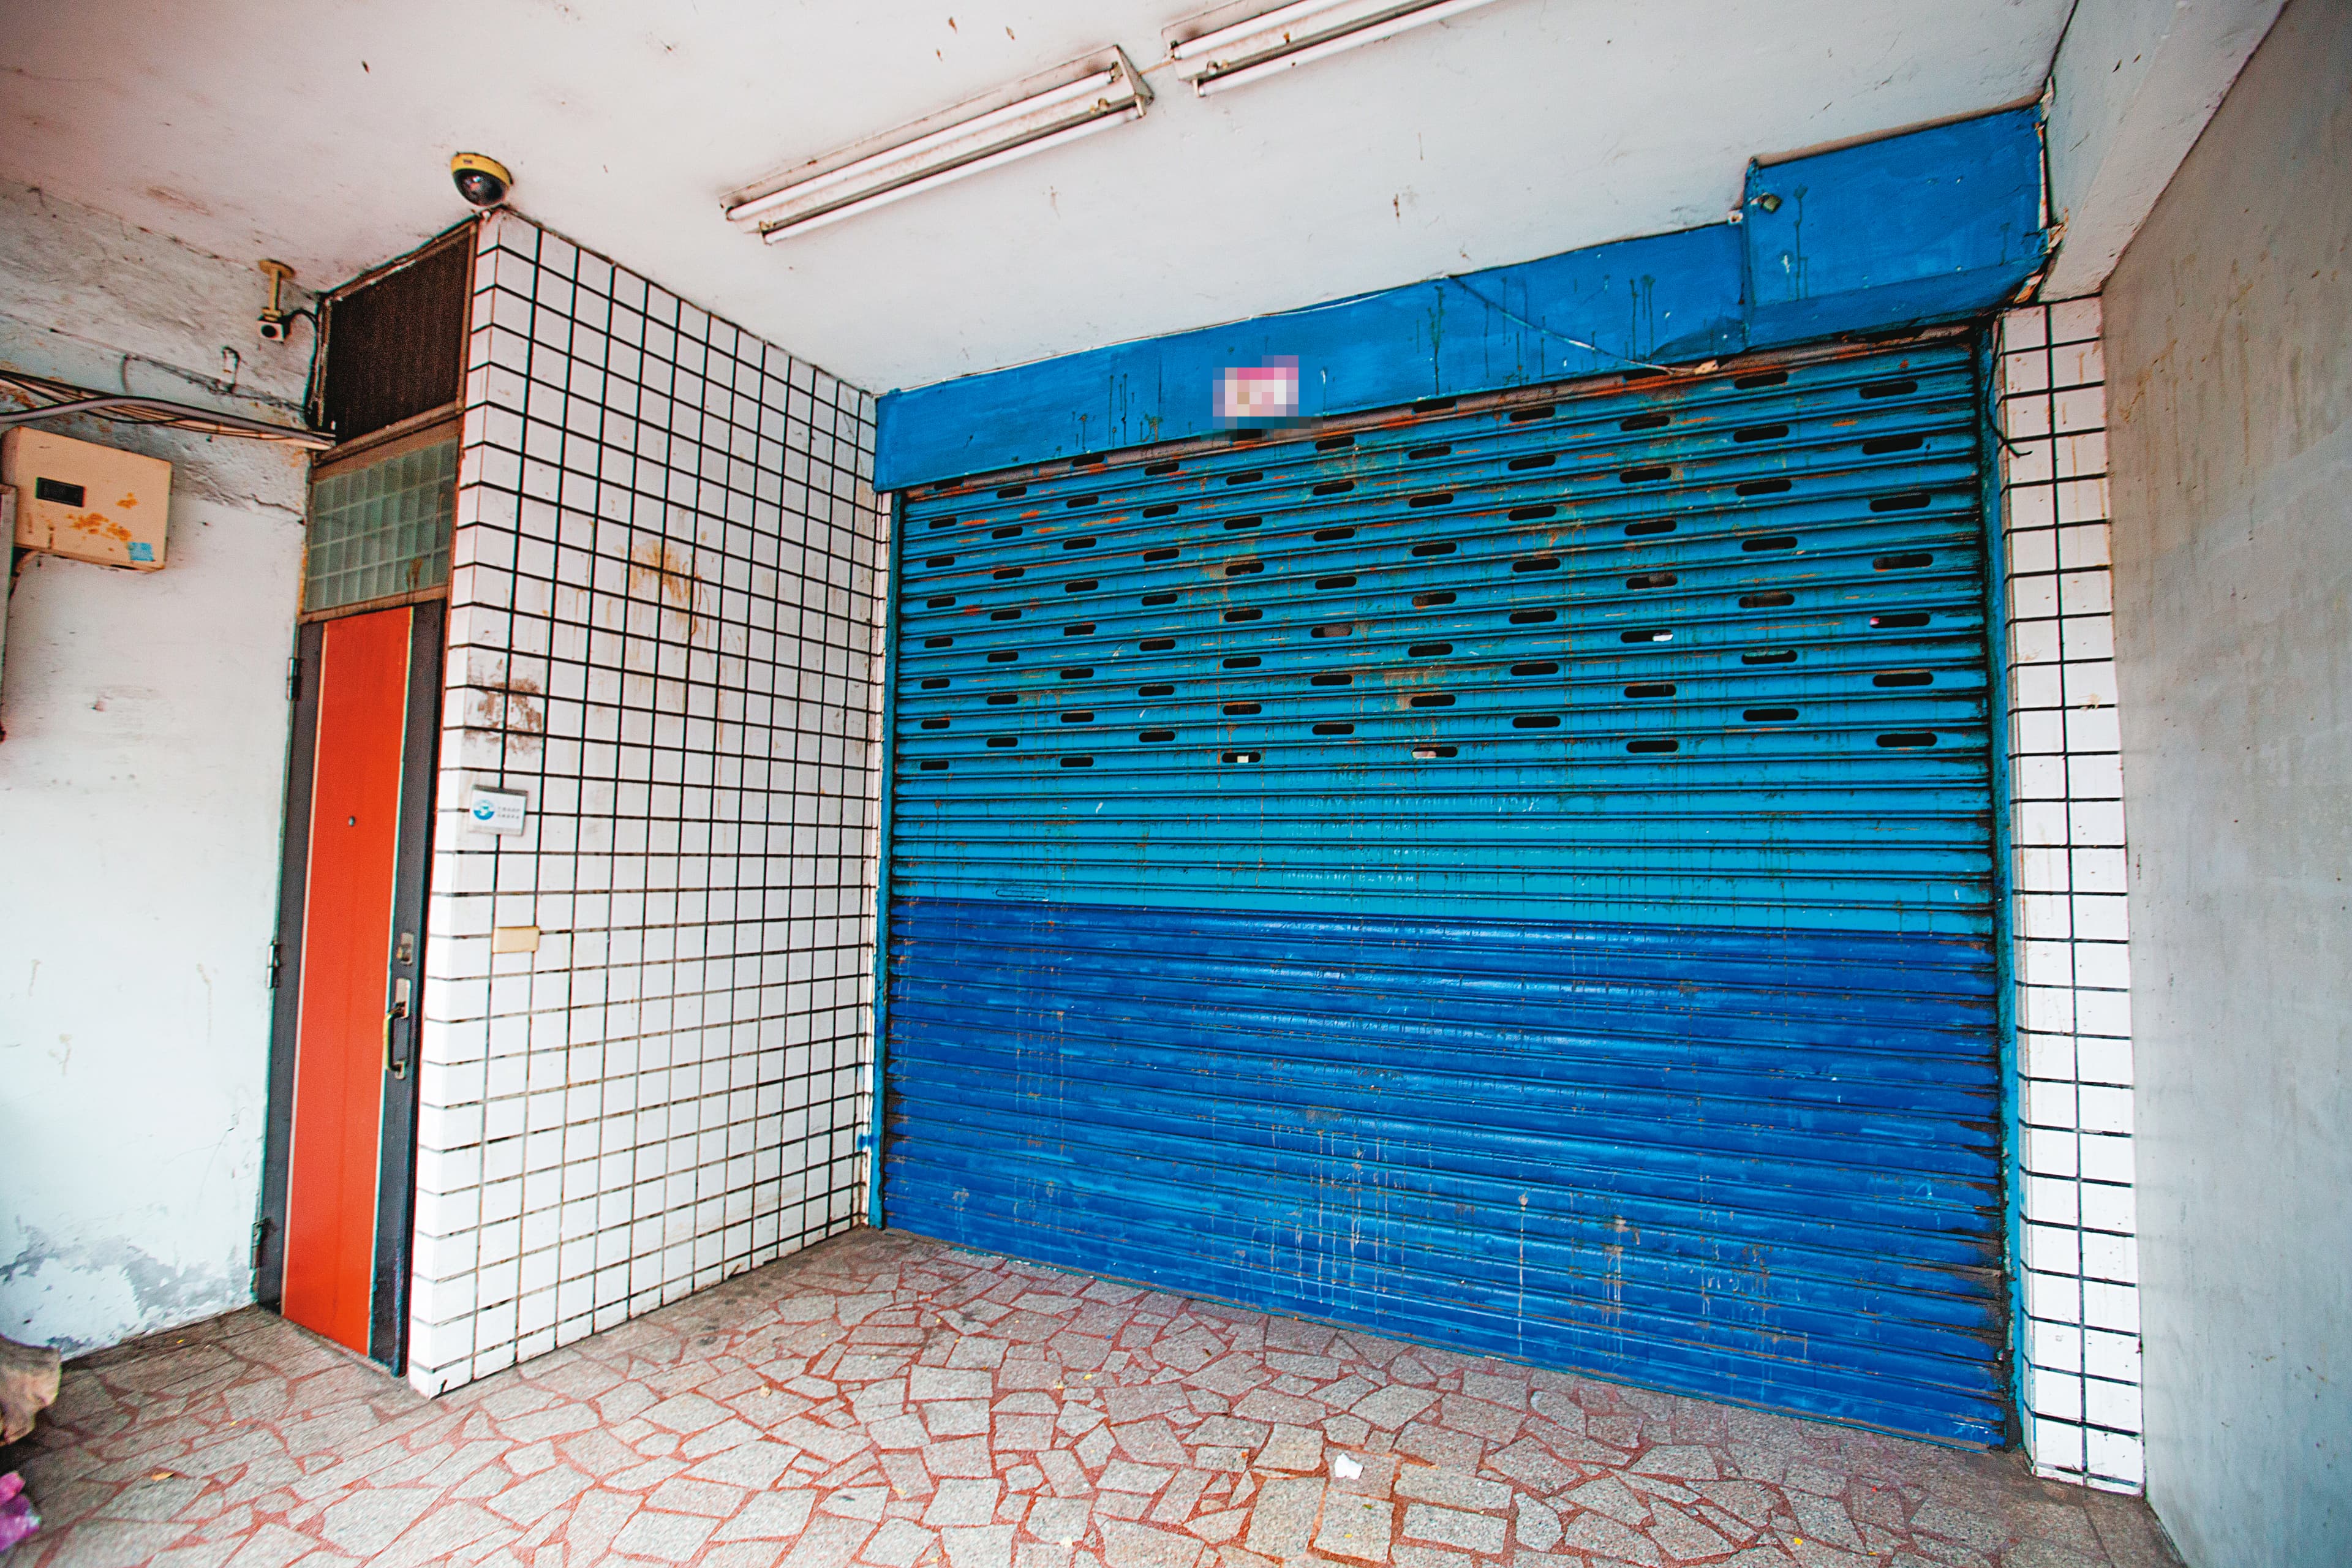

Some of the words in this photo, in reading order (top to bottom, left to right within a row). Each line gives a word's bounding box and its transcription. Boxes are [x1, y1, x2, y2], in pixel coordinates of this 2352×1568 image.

[1289, 797, 1342, 809] SUNDAY
[1385, 797, 1457, 807] NATIONAL
[1470, 797, 1540, 807] HOLIDAY
